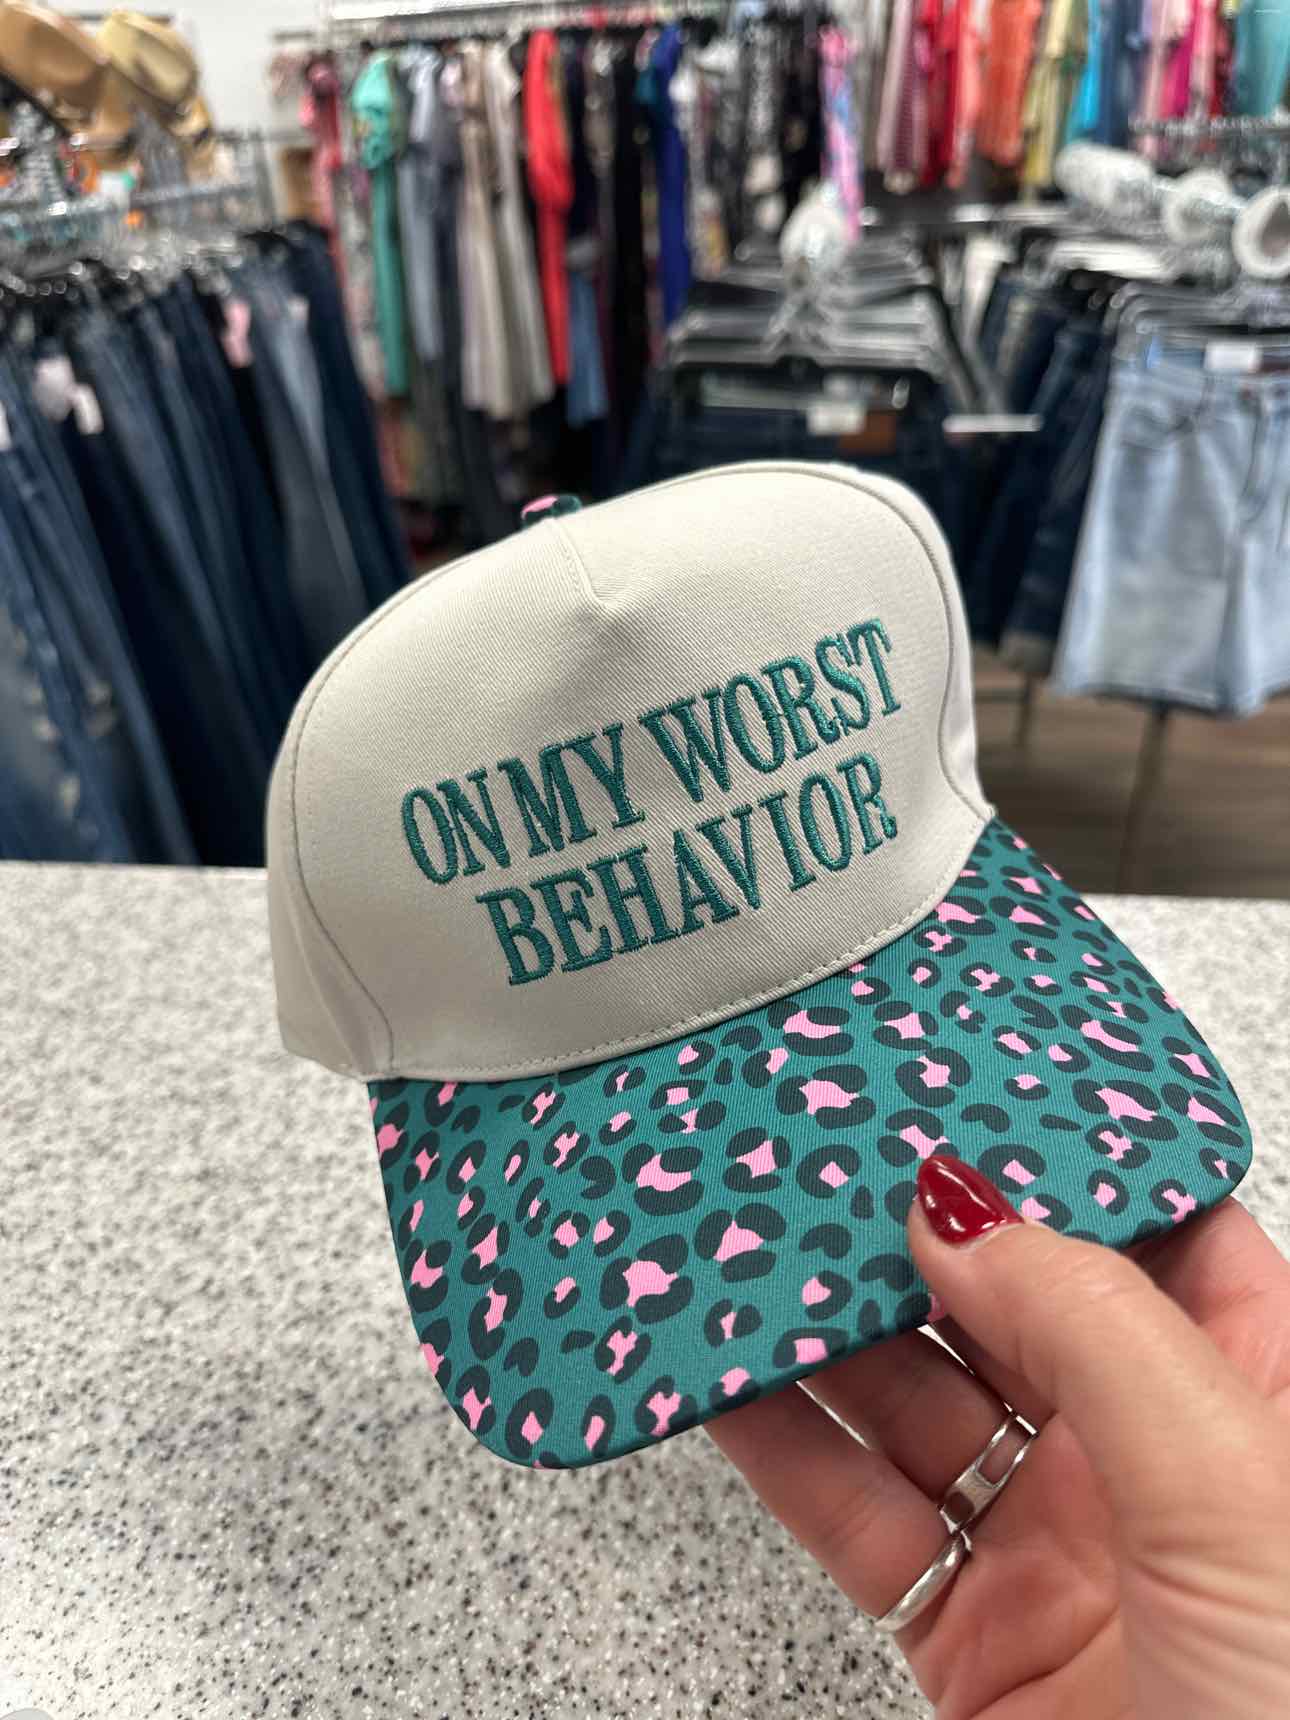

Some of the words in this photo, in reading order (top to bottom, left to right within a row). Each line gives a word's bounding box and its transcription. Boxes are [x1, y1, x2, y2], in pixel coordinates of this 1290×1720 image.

[402, 769, 510, 885] ON
[497, 722, 646, 858] MY
[638, 618, 901, 801] WORST
[476, 752, 898, 985] BEHAVIOR
